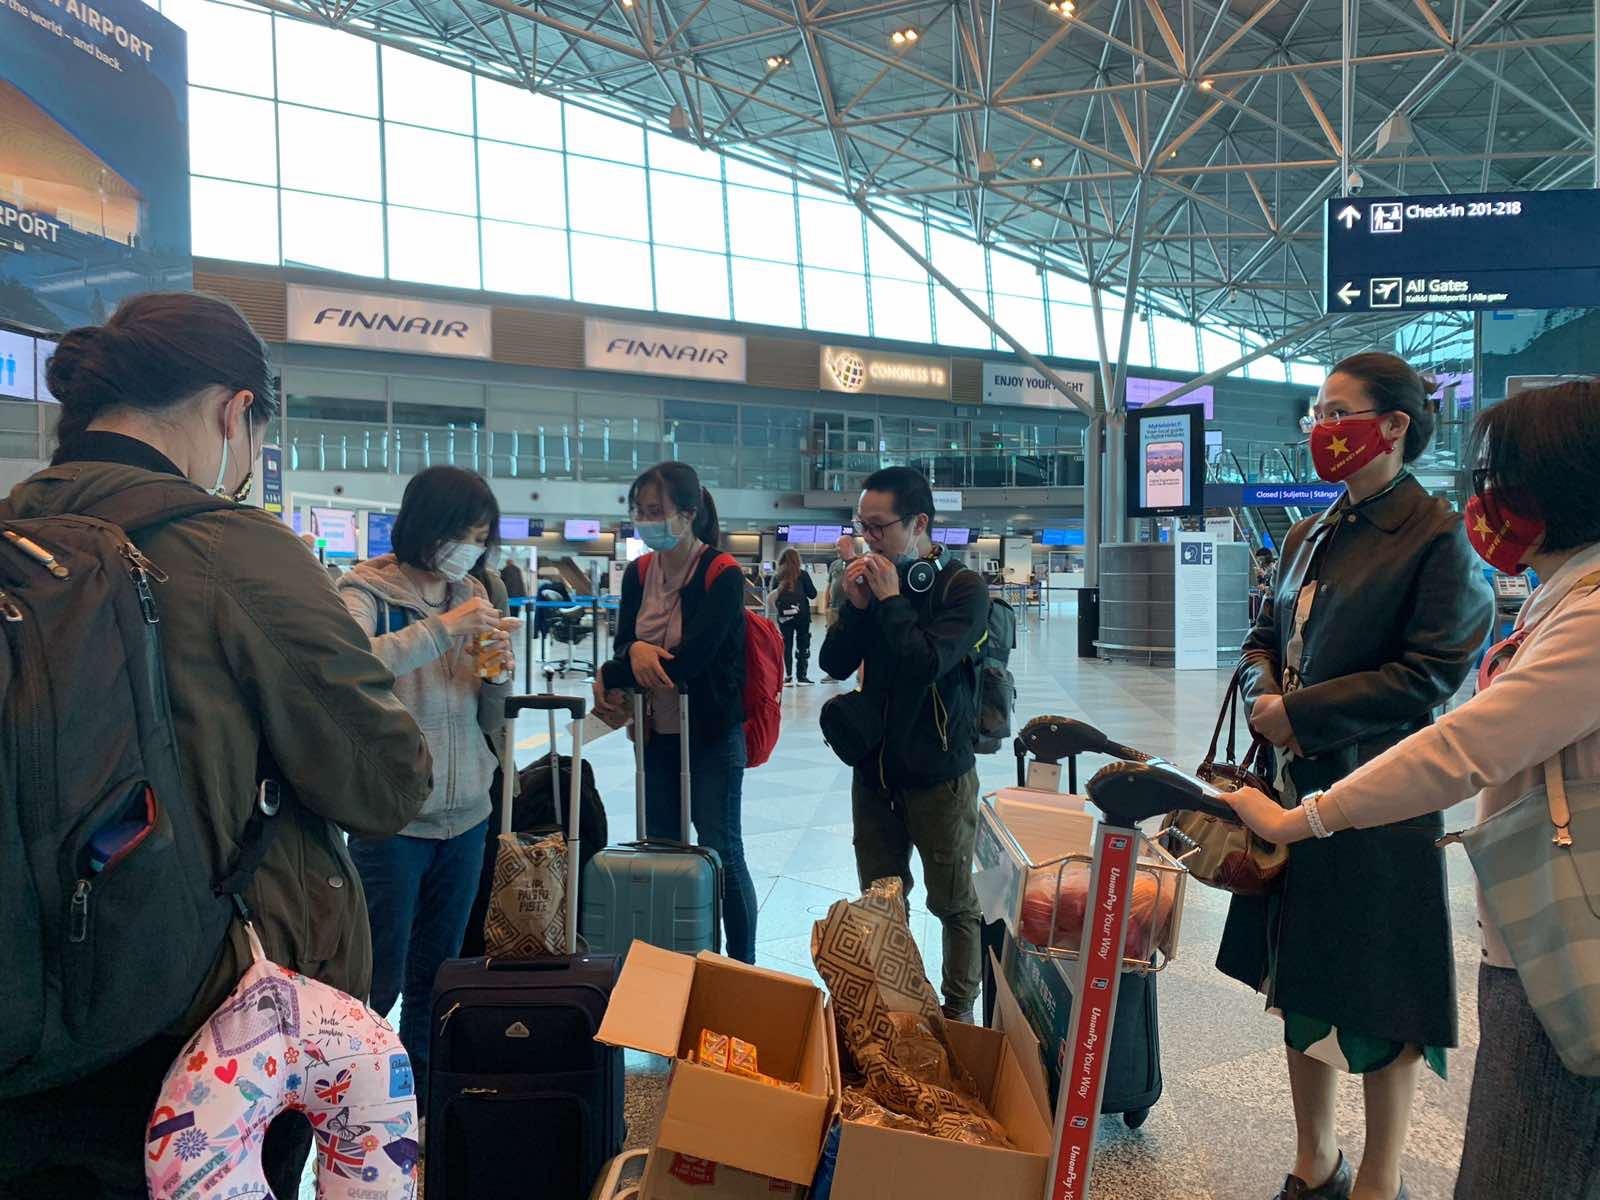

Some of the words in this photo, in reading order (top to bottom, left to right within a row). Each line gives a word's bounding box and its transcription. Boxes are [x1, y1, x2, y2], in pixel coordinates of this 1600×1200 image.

[30, 10, 64, 37] world
[73, 36, 94, 56] and
[95, 48, 124, 72] back.
[66, 0, 154, 62] AIRPORT
[1406, 203, 1465, 219] Check-in
[1467, 201, 1522, 216] 201-218
[1406, 279, 1425, 293] All
[1429, 279, 1469, 293] Gates
[313, 307, 469, 338] FINNAIR
[606, 338, 729, 364] FINNAIR
[994, 375, 1024, 387] ENJOY
[1026, 377, 1051, 390] YOUR
[1256, 490, 1279, 498] Closed
[1283, 490, 1309, 499] Suljettu
[1103, 867, 1121, 911] UnionPay
[1103, 913, 1114, 939] Your
[1098, 939, 1111, 960] Way
[320, 1017, 340, 1026] Hello
[1083, 1007, 1102, 1050] UnionPay
[1083, 1050, 1096, 1074] Your
[1078, 1076, 1092, 1099] Way
[1062, 1145, 1081, 1189] UnionPay
